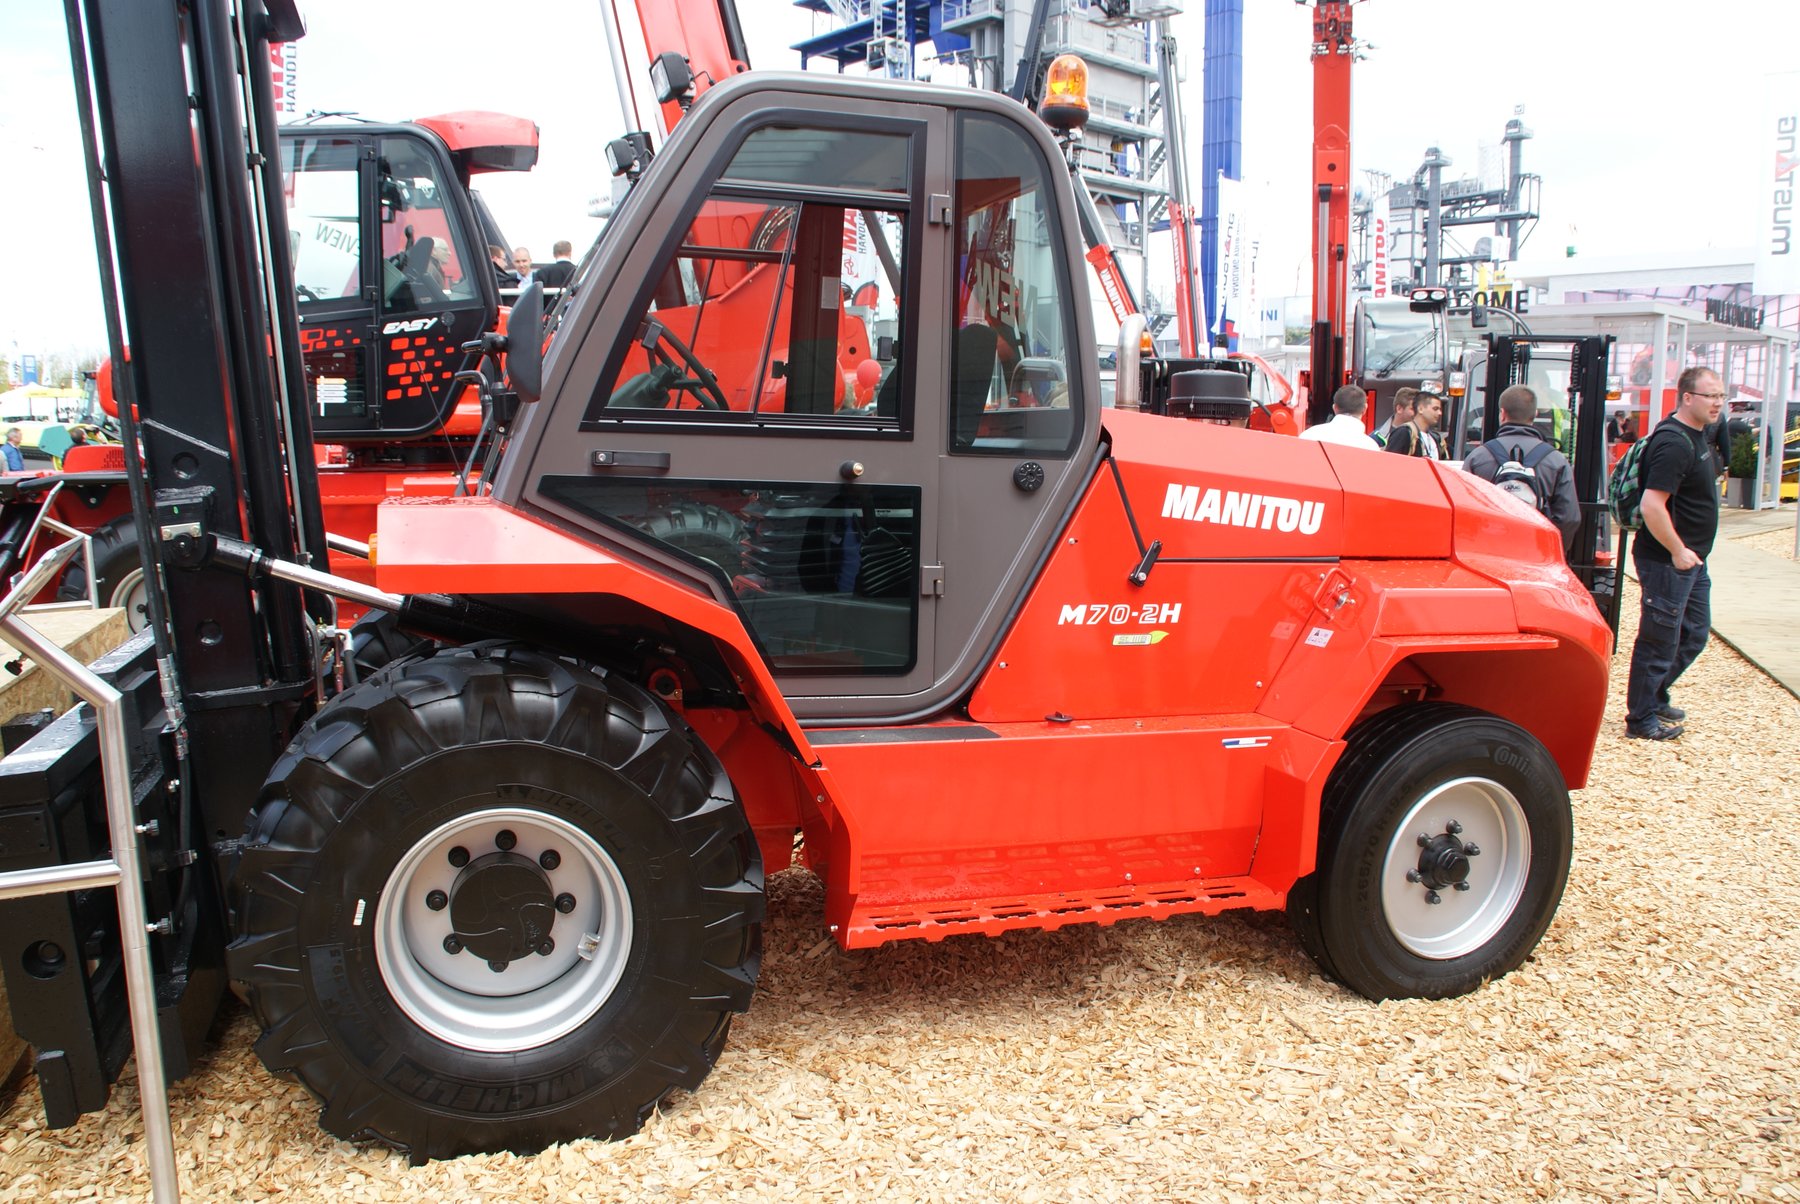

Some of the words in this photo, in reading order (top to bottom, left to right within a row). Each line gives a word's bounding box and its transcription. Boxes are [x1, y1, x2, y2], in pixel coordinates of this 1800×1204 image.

[382, 317, 438, 334] EASY
[1161, 483, 1326, 535] MANITOU
[1058, 603, 1182, 625] M70-2H
